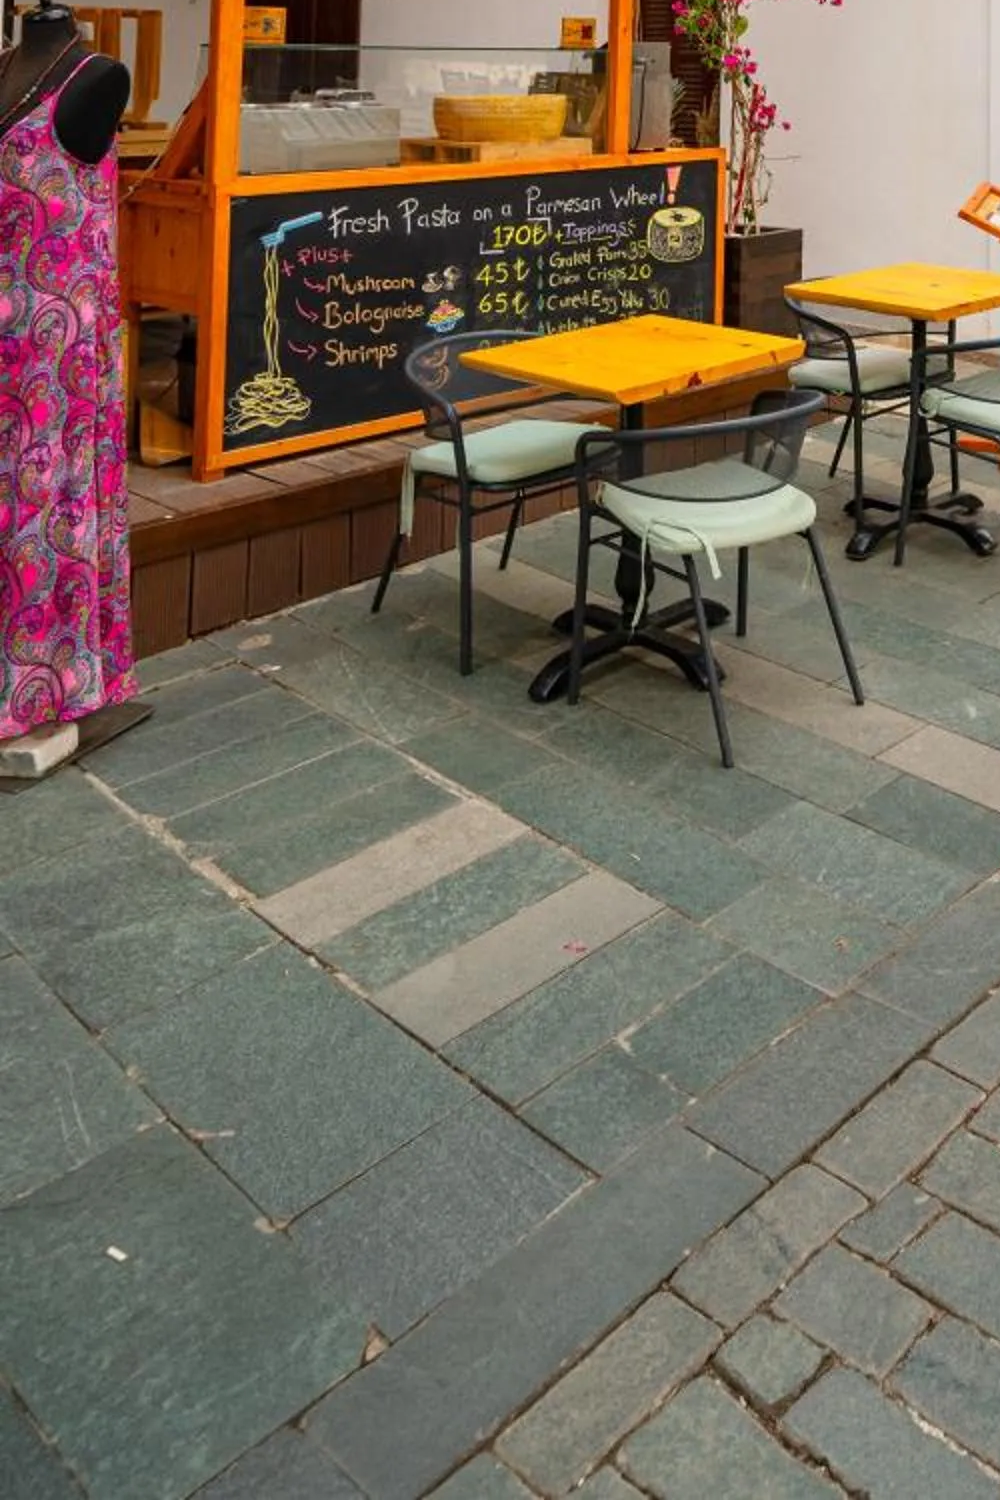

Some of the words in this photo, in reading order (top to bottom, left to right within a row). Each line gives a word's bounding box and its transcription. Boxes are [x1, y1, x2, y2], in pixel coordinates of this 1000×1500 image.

[328, 205, 390, 239] Fresh
[397, 197, 461, 235] Pasta
[473, 207, 493, 221] on
[501, 203, 513, 217] a
[525, 185, 601, 216] Parmesan
[326, 273, 415, 295] Mushroom
[324, 339, 398, 369] Shrimps
